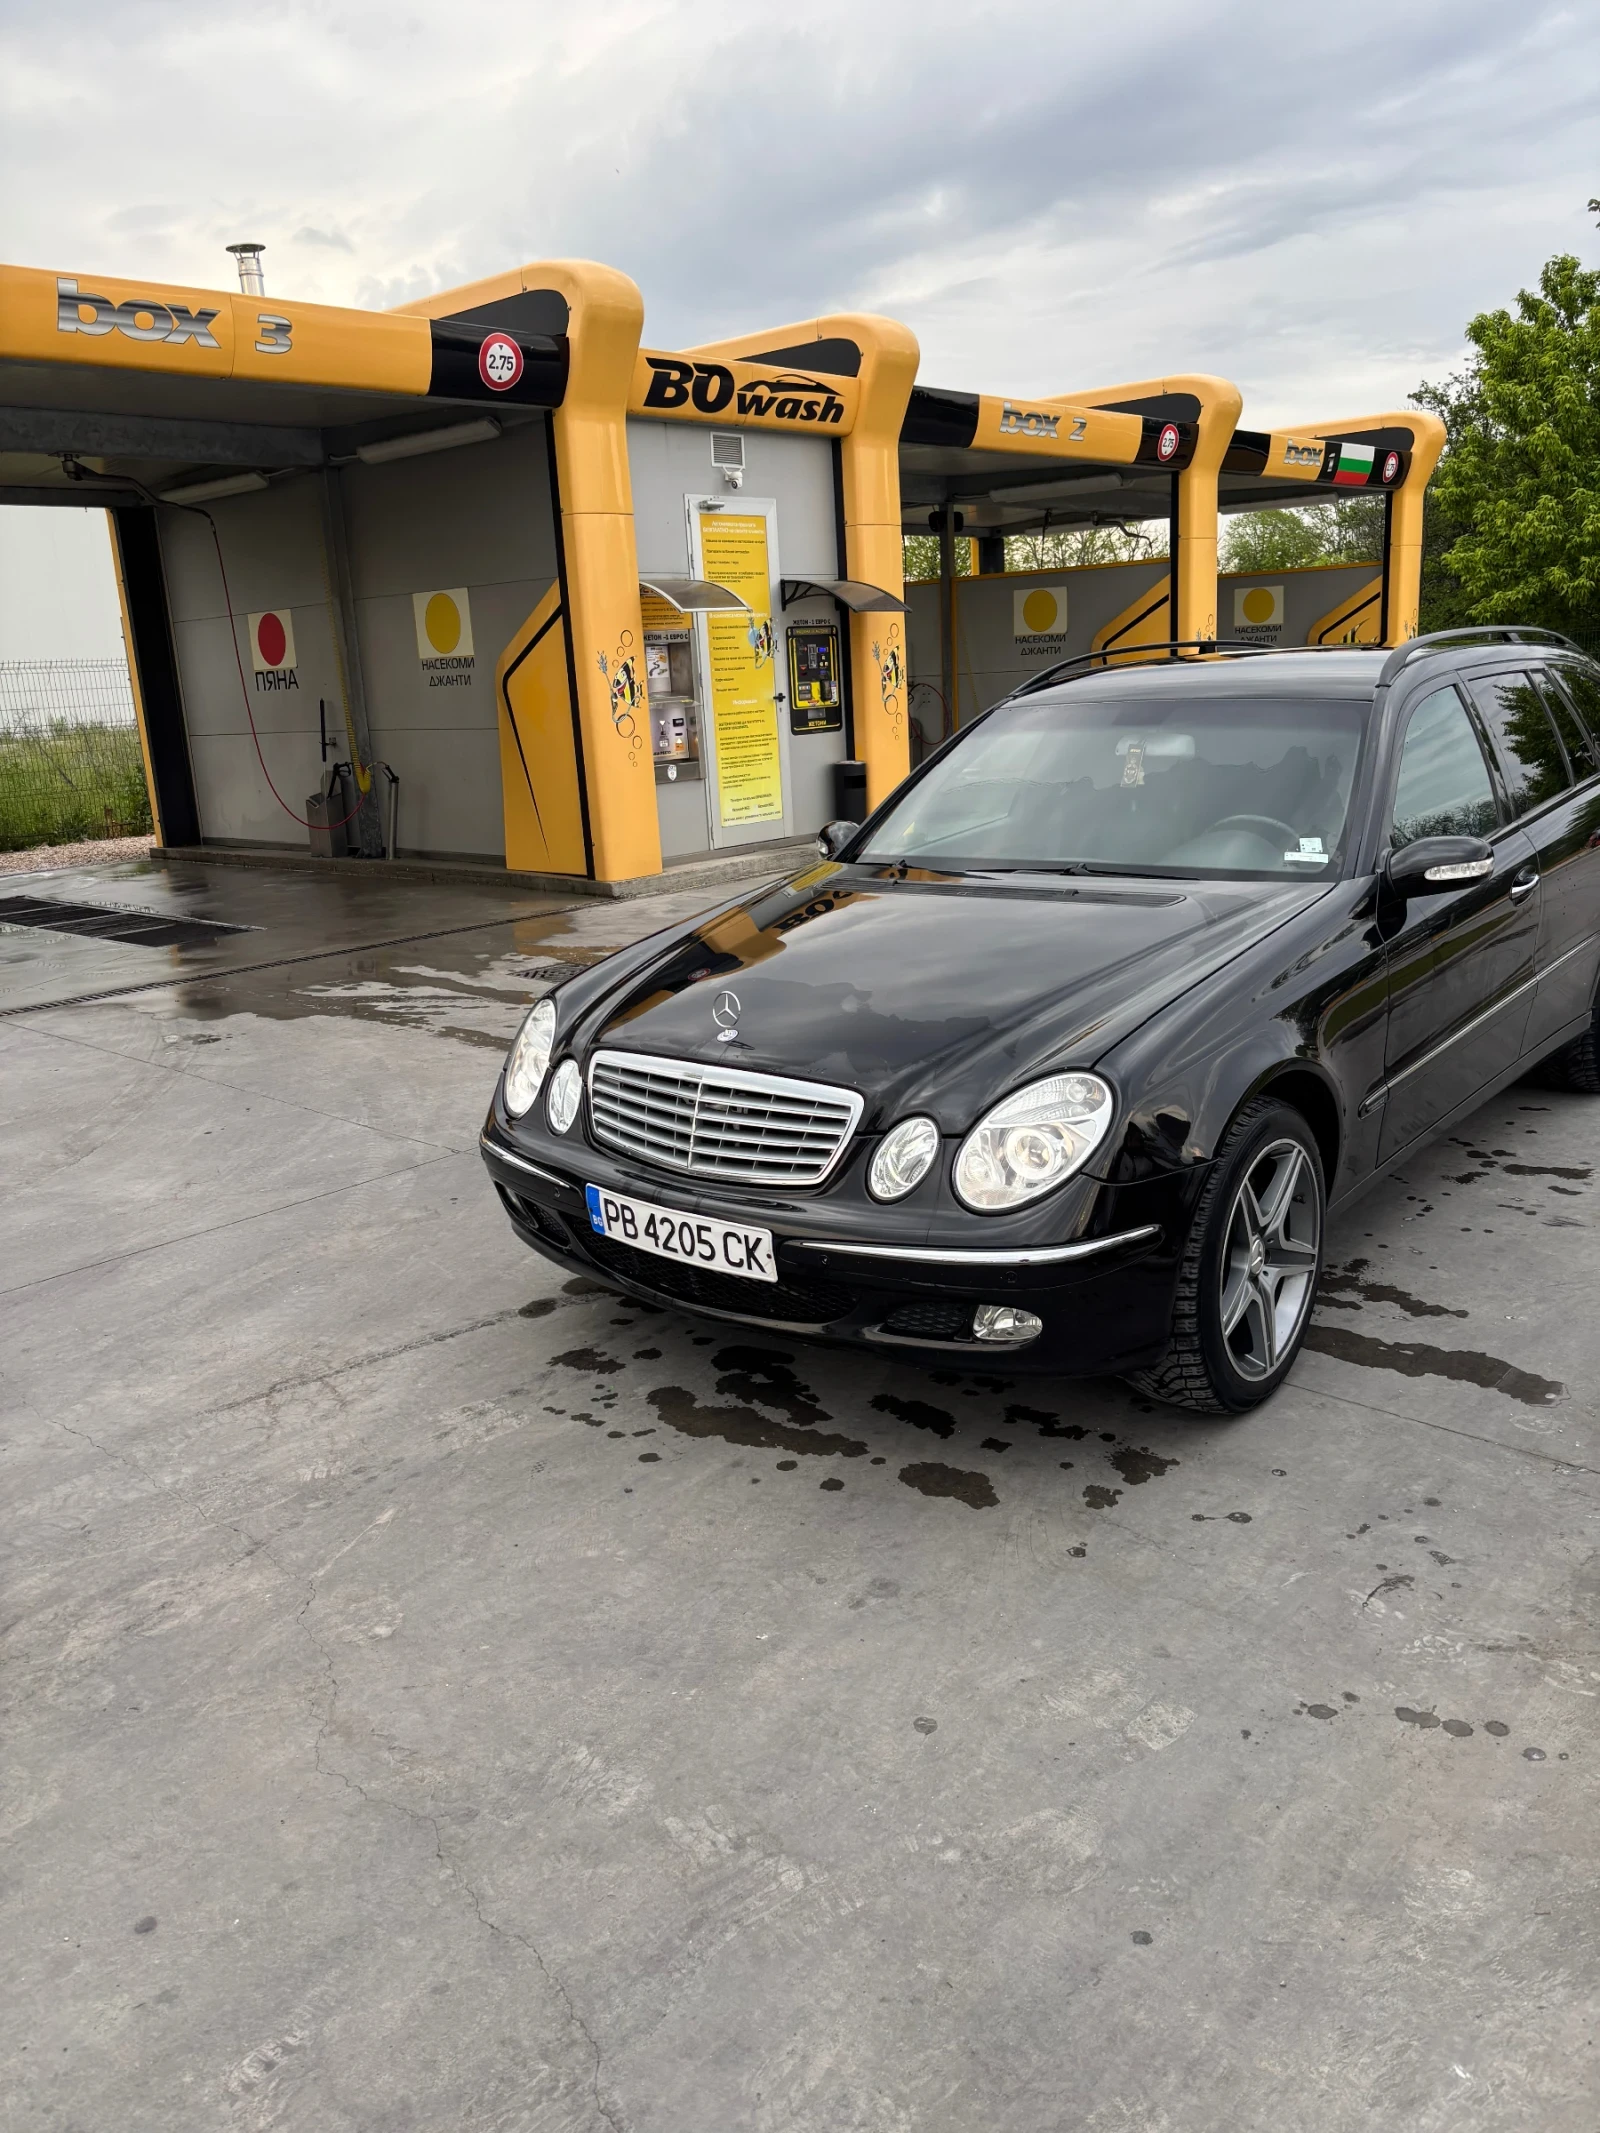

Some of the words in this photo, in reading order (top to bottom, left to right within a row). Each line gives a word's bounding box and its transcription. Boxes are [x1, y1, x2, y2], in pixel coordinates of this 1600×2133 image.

[57, 277, 222, 349] box
[255, 314, 293, 355] 3
[488, 354, 514, 371] 2.75
[643, 356, 735, 414] BO
[736, 391, 845, 424] wash
[999, 401, 1062, 439] box
[1068, 416, 1088, 442] 2
[1162, 437, 1175, 449] 2.75
[1283, 438, 1324, 467] box
[1326, 452, 1336, 472] 1
[1234, 625, 1282, 634] НАСЕКОМИ
[1015, 634, 1066, 644] НАСЕКОМИ
[1020, 646, 1061, 656] ДЖАНТИ
[421, 657, 475, 671] НАСЕКОМИ
[255, 669, 300, 691] ПЯНА
[429, 674, 472, 687] ДЖАНТИ
[592, 1214, 603, 1226] BG
[603, 1197, 639, 1240] PB
[644, 1212, 716, 1262] 4205
[722, 1231, 767, 1274] CK
